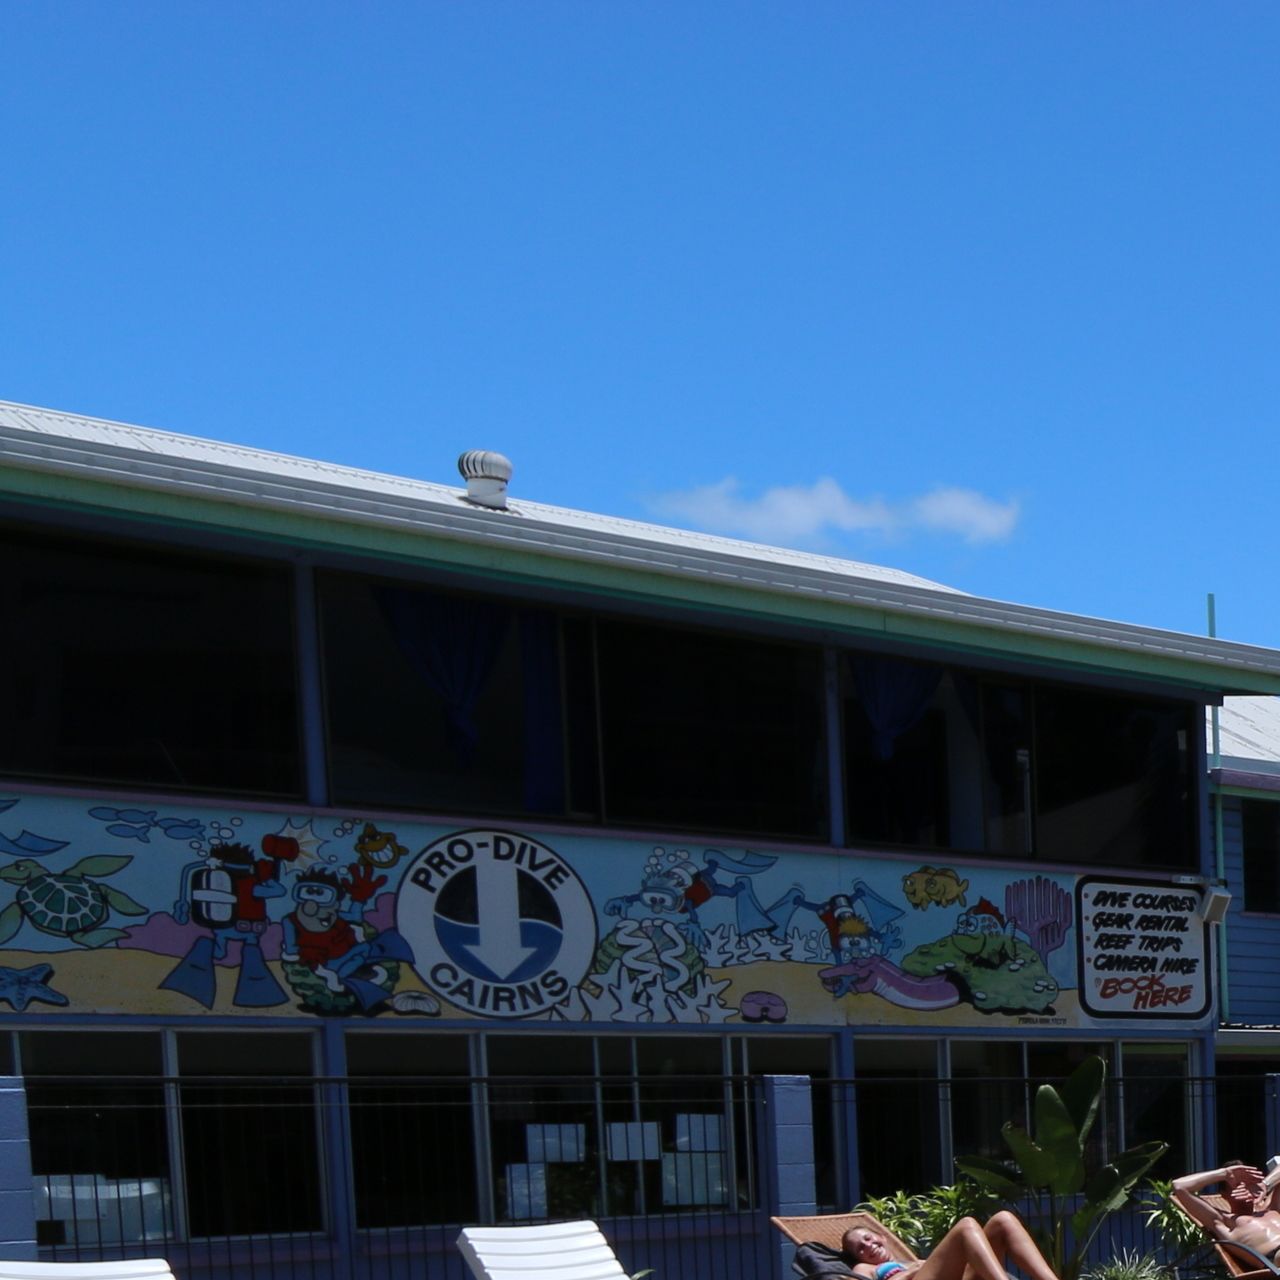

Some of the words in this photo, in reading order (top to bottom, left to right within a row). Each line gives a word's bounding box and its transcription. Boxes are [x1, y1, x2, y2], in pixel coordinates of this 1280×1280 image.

[410, 835, 571, 893] PRO-DIVE
[1092, 891, 1131, 907] DIVE
[1133, 893, 1196, 913] COURSES
[1092, 911, 1134, 931] GEAR
[1135, 914, 1189, 932] RENTAL
[1094, 933, 1135, 950] REEF
[1139, 935, 1183, 953] TRIPS
[1093, 954, 1158, 973] CAMERA
[1160, 957, 1199, 975] HIRE
[430, 963, 569, 1012] CAIRNS
[1100, 974, 1166, 999] BOOK
[1133, 985, 1193, 1010] HERE
